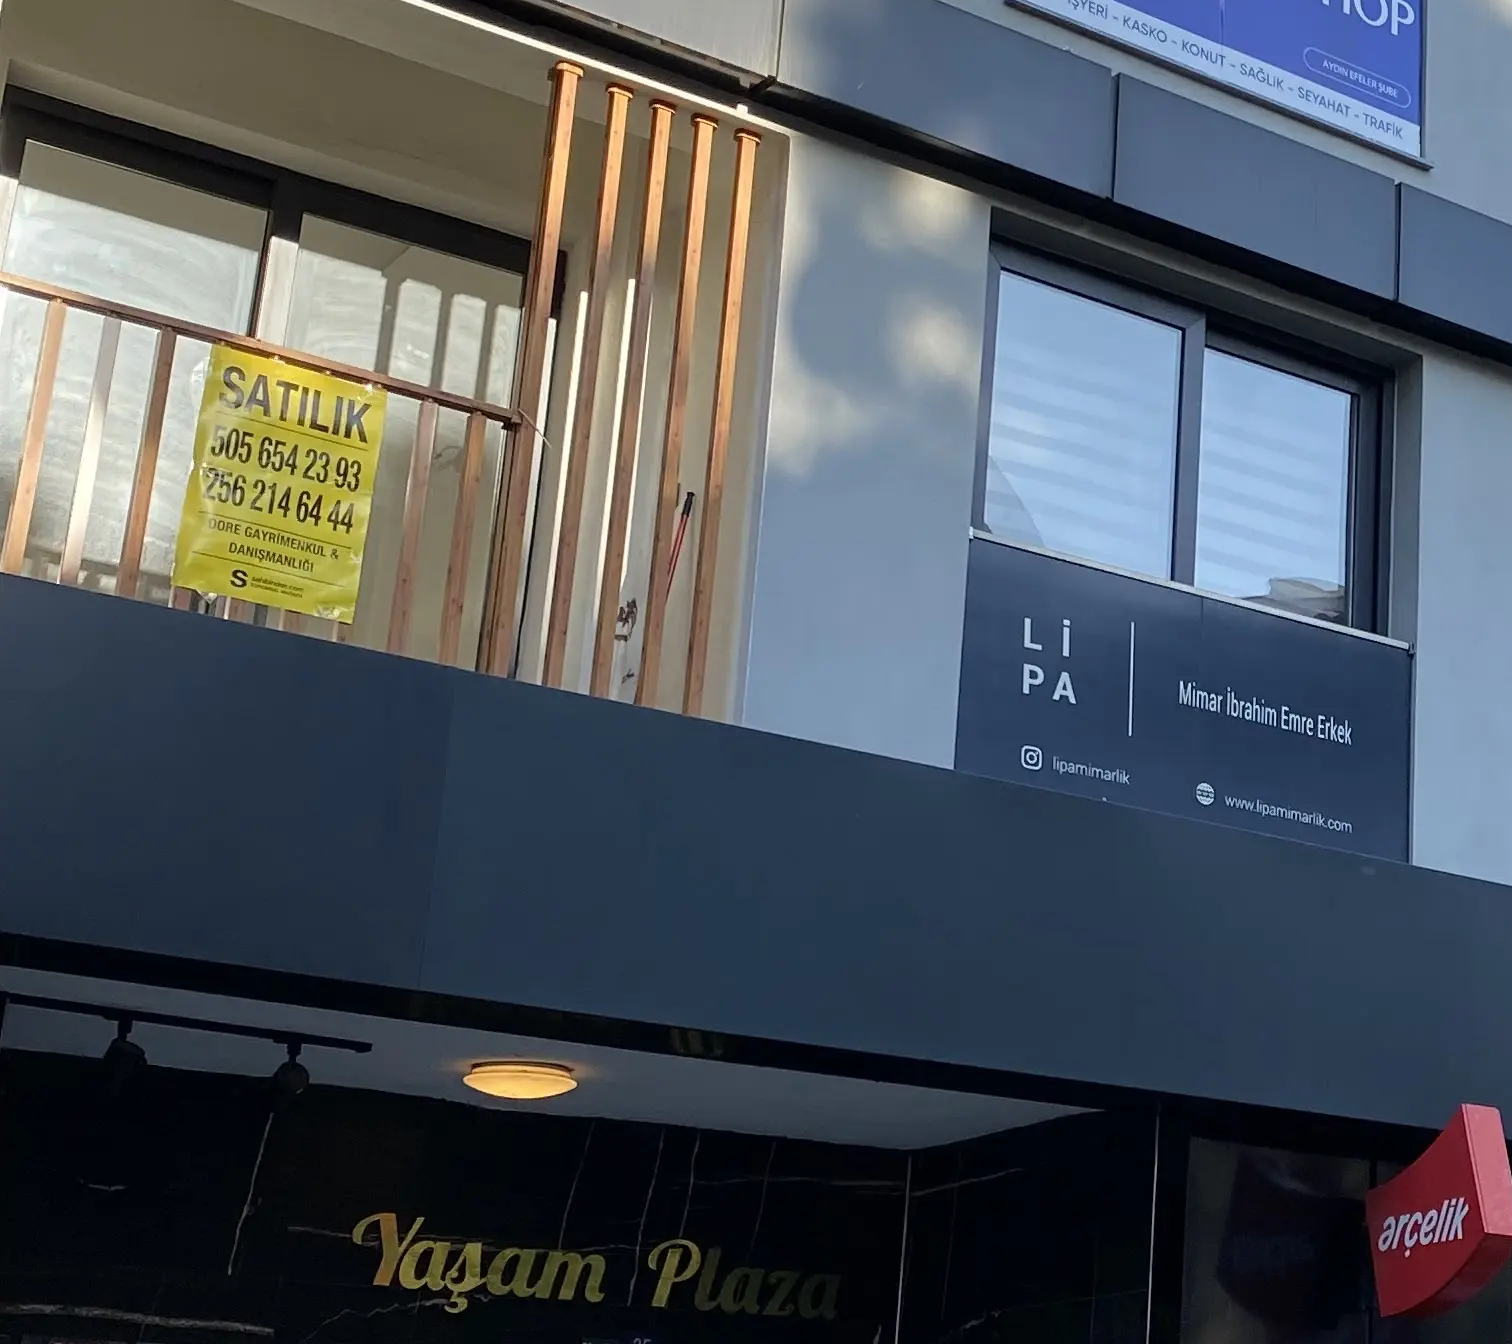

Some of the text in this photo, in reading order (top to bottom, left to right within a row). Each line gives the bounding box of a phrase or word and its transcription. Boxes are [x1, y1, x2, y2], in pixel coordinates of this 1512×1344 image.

[1122, 15, 1167, 44] KASKO
[1181, 39, 1226, 68] KONUT
[1240, 62, 1284, 92] SAĞLIK
[1297, 86, 1351, 118] SEYAHAT
[1362, 111, 1403, 139] TRAFİK
[1322, 59, 1348, 77] AYDIN
[1349, 70, 1377, 90] EFELER
[218, 365, 373, 444] SATILIK
[210, 423, 362, 493] 505 654 23 93
[202, 467, 354, 535] 256 214 64 44
[228, 542, 314, 573] DANIŞMANLIĞI
[244, 525, 327, 558] GAYRİMENKUL
[330, 548, 339, 560] &
[230, 569, 248, 589] S
[1022, 663, 1077, 705] PA
[1179, 680, 1353, 746] Mimar İbrahim Emre Erkek
[1052, 756, 1131, 785] lipamimarlik
[1225, 794, 1353, 834] www.lipamimarlik.com
[1377, 1197, 1469, 1257] arçelik
[351, 1212, 844, 1320] Yaşam Plaza
